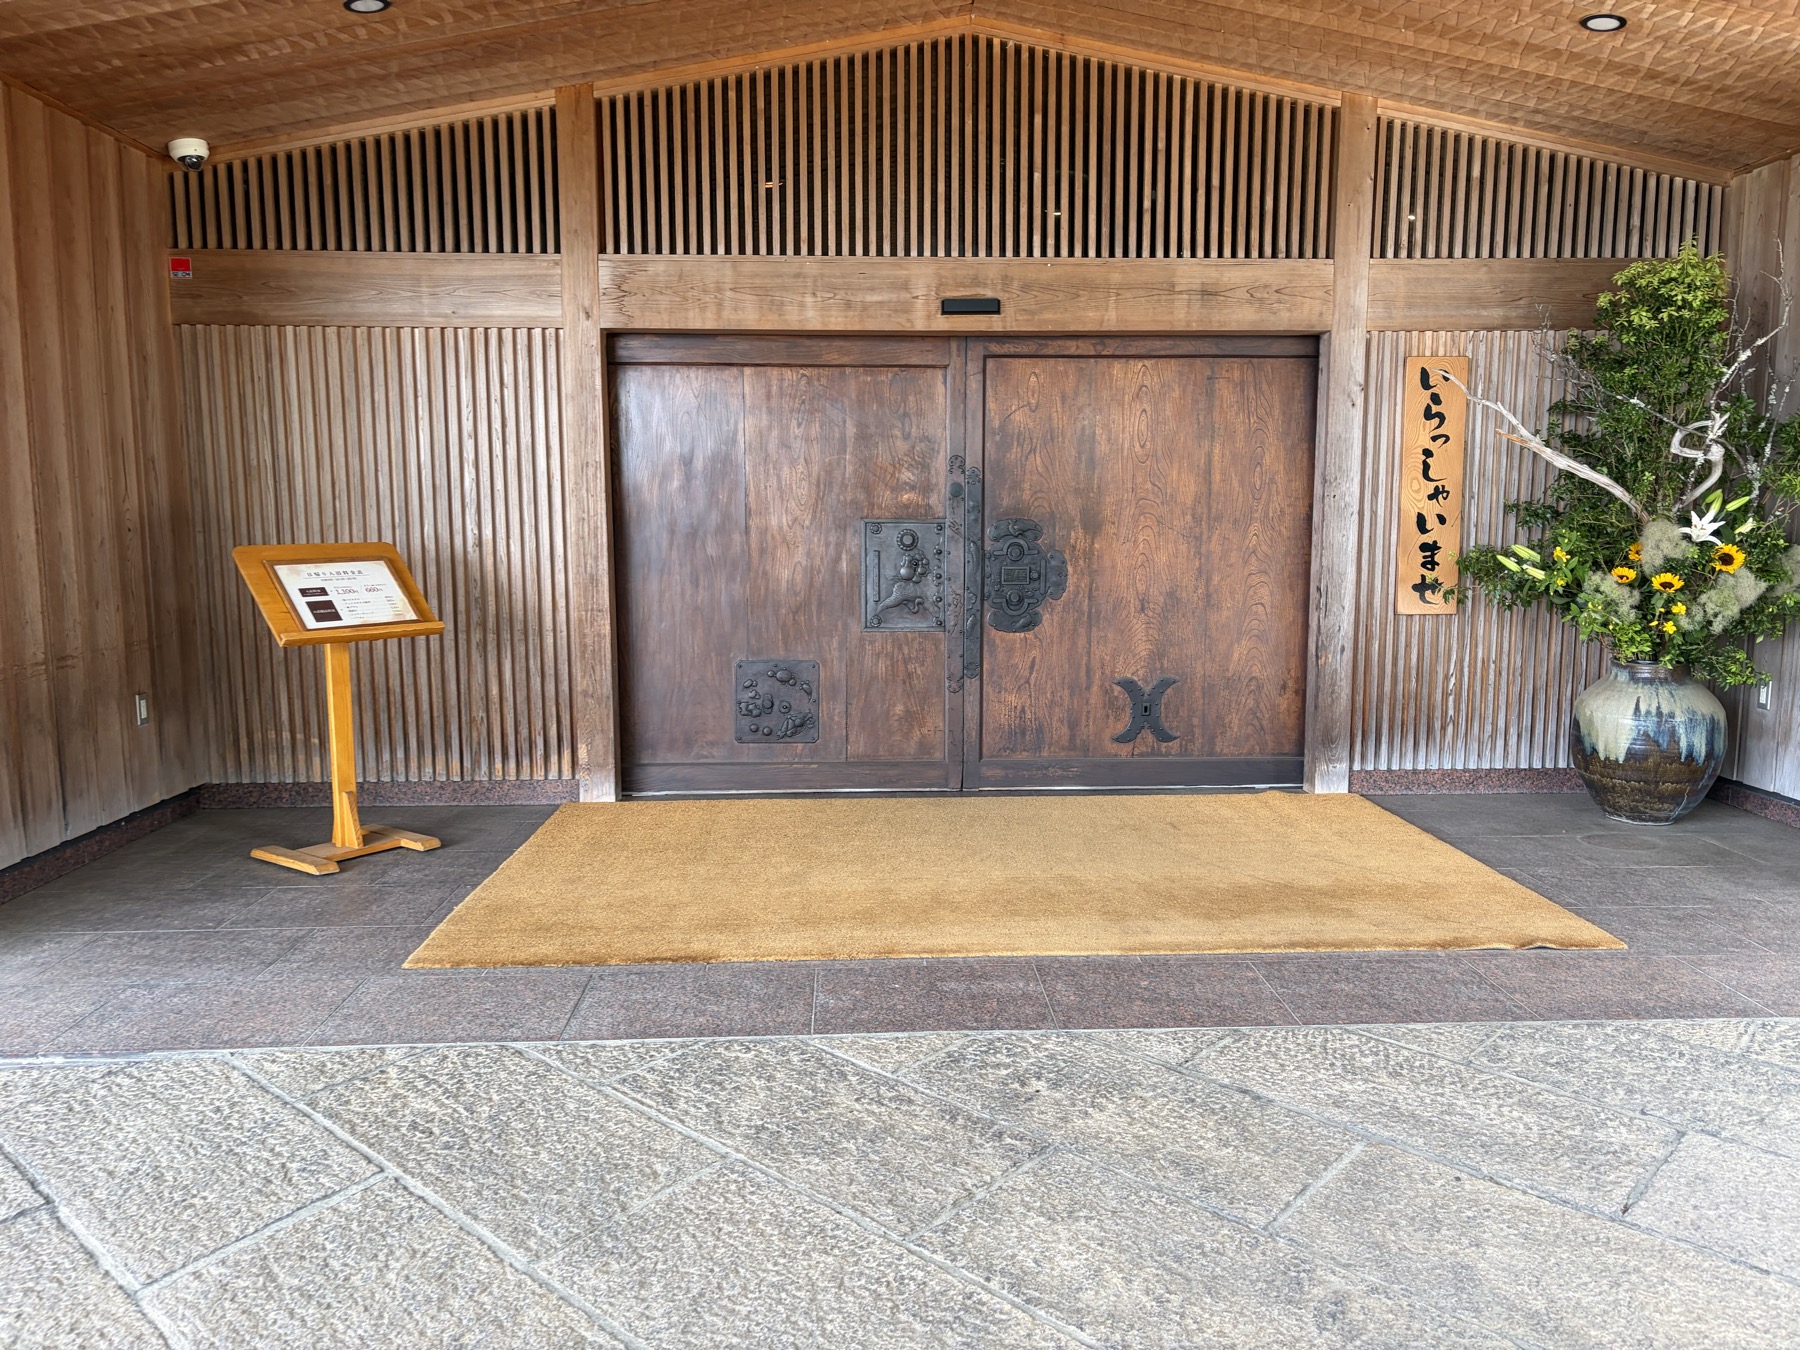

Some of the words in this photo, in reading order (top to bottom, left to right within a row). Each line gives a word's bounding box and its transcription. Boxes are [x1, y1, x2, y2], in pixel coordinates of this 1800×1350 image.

[1411, 366, 1451, 606] いらっしゃいませ
